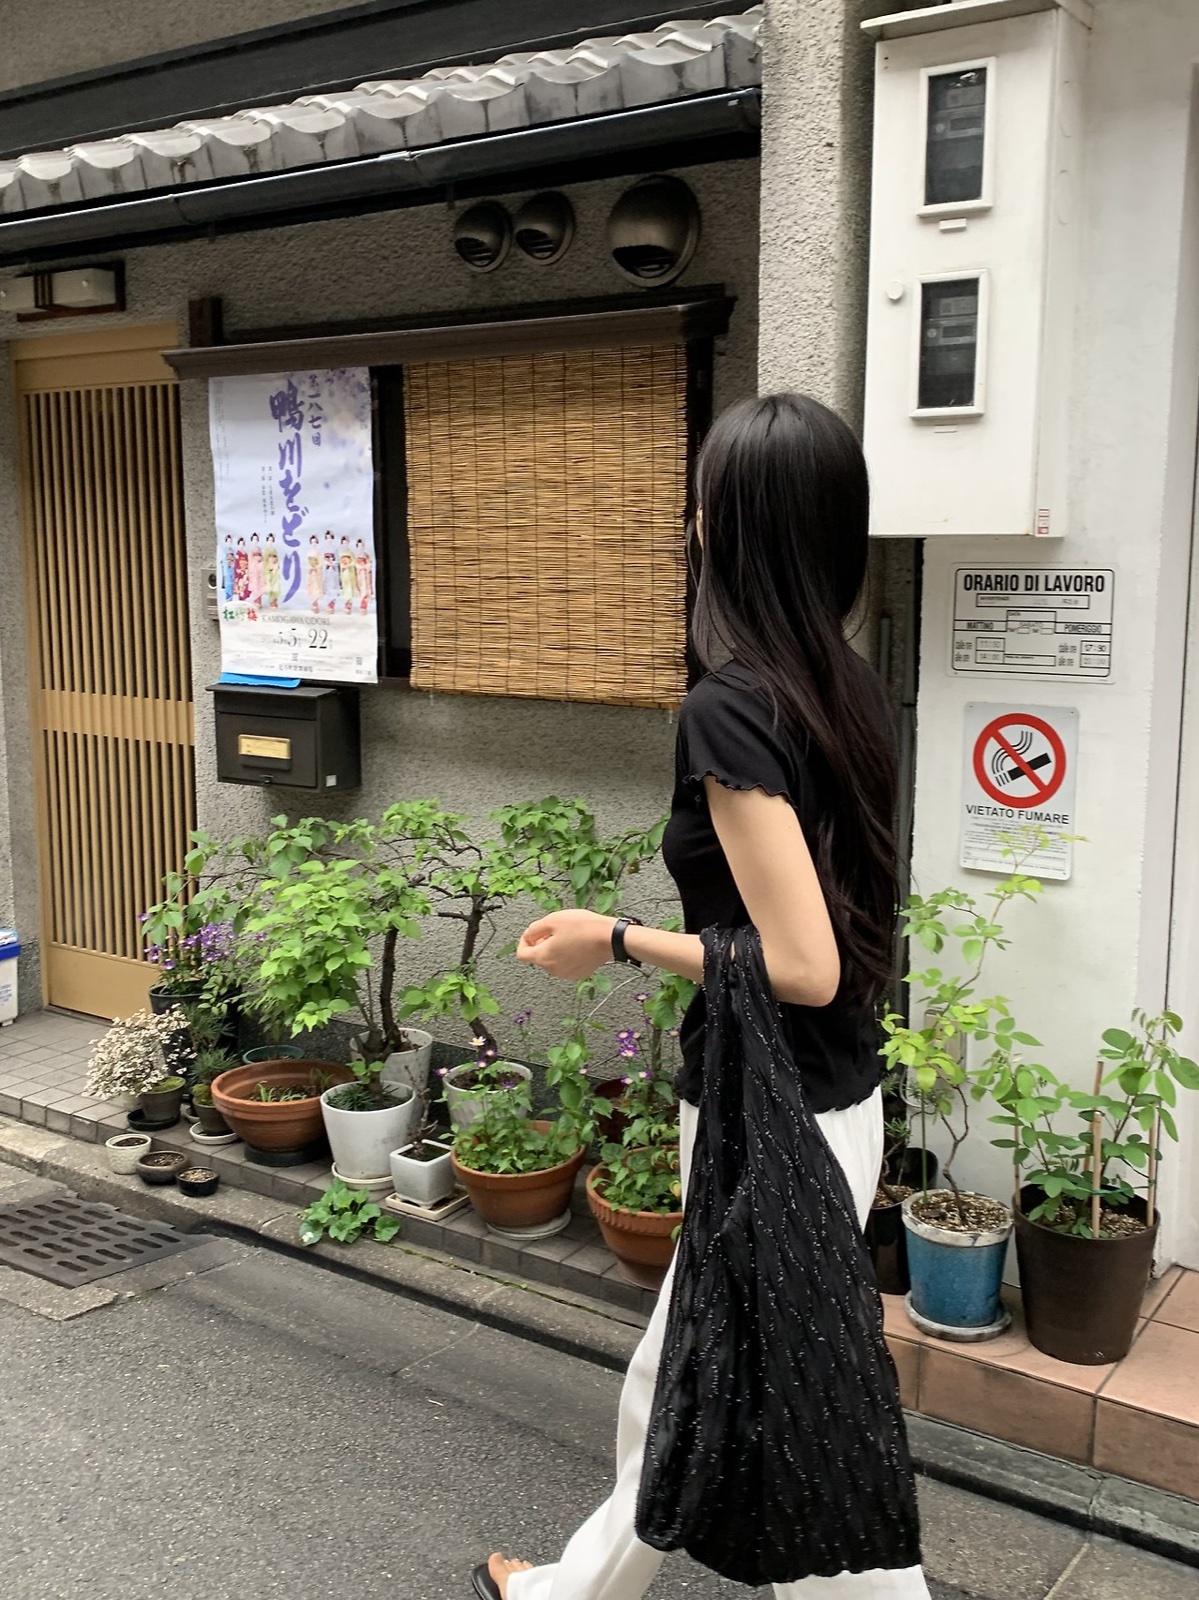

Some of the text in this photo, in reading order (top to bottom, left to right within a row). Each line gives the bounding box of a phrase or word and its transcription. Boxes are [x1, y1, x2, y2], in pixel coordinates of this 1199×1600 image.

[269, 379, 310, 603] 鴨川をどり
[963, 574, 1105, 593] ORARIO DI LAVORO
[262, 614, 304, 625] KAMOGAWA
[966, 621, 994, 631] MATTINO
[1064, 624, 1102, 634] POMERIGGIO
[965, 804, 1070, 825] VIETATO FUMARE
